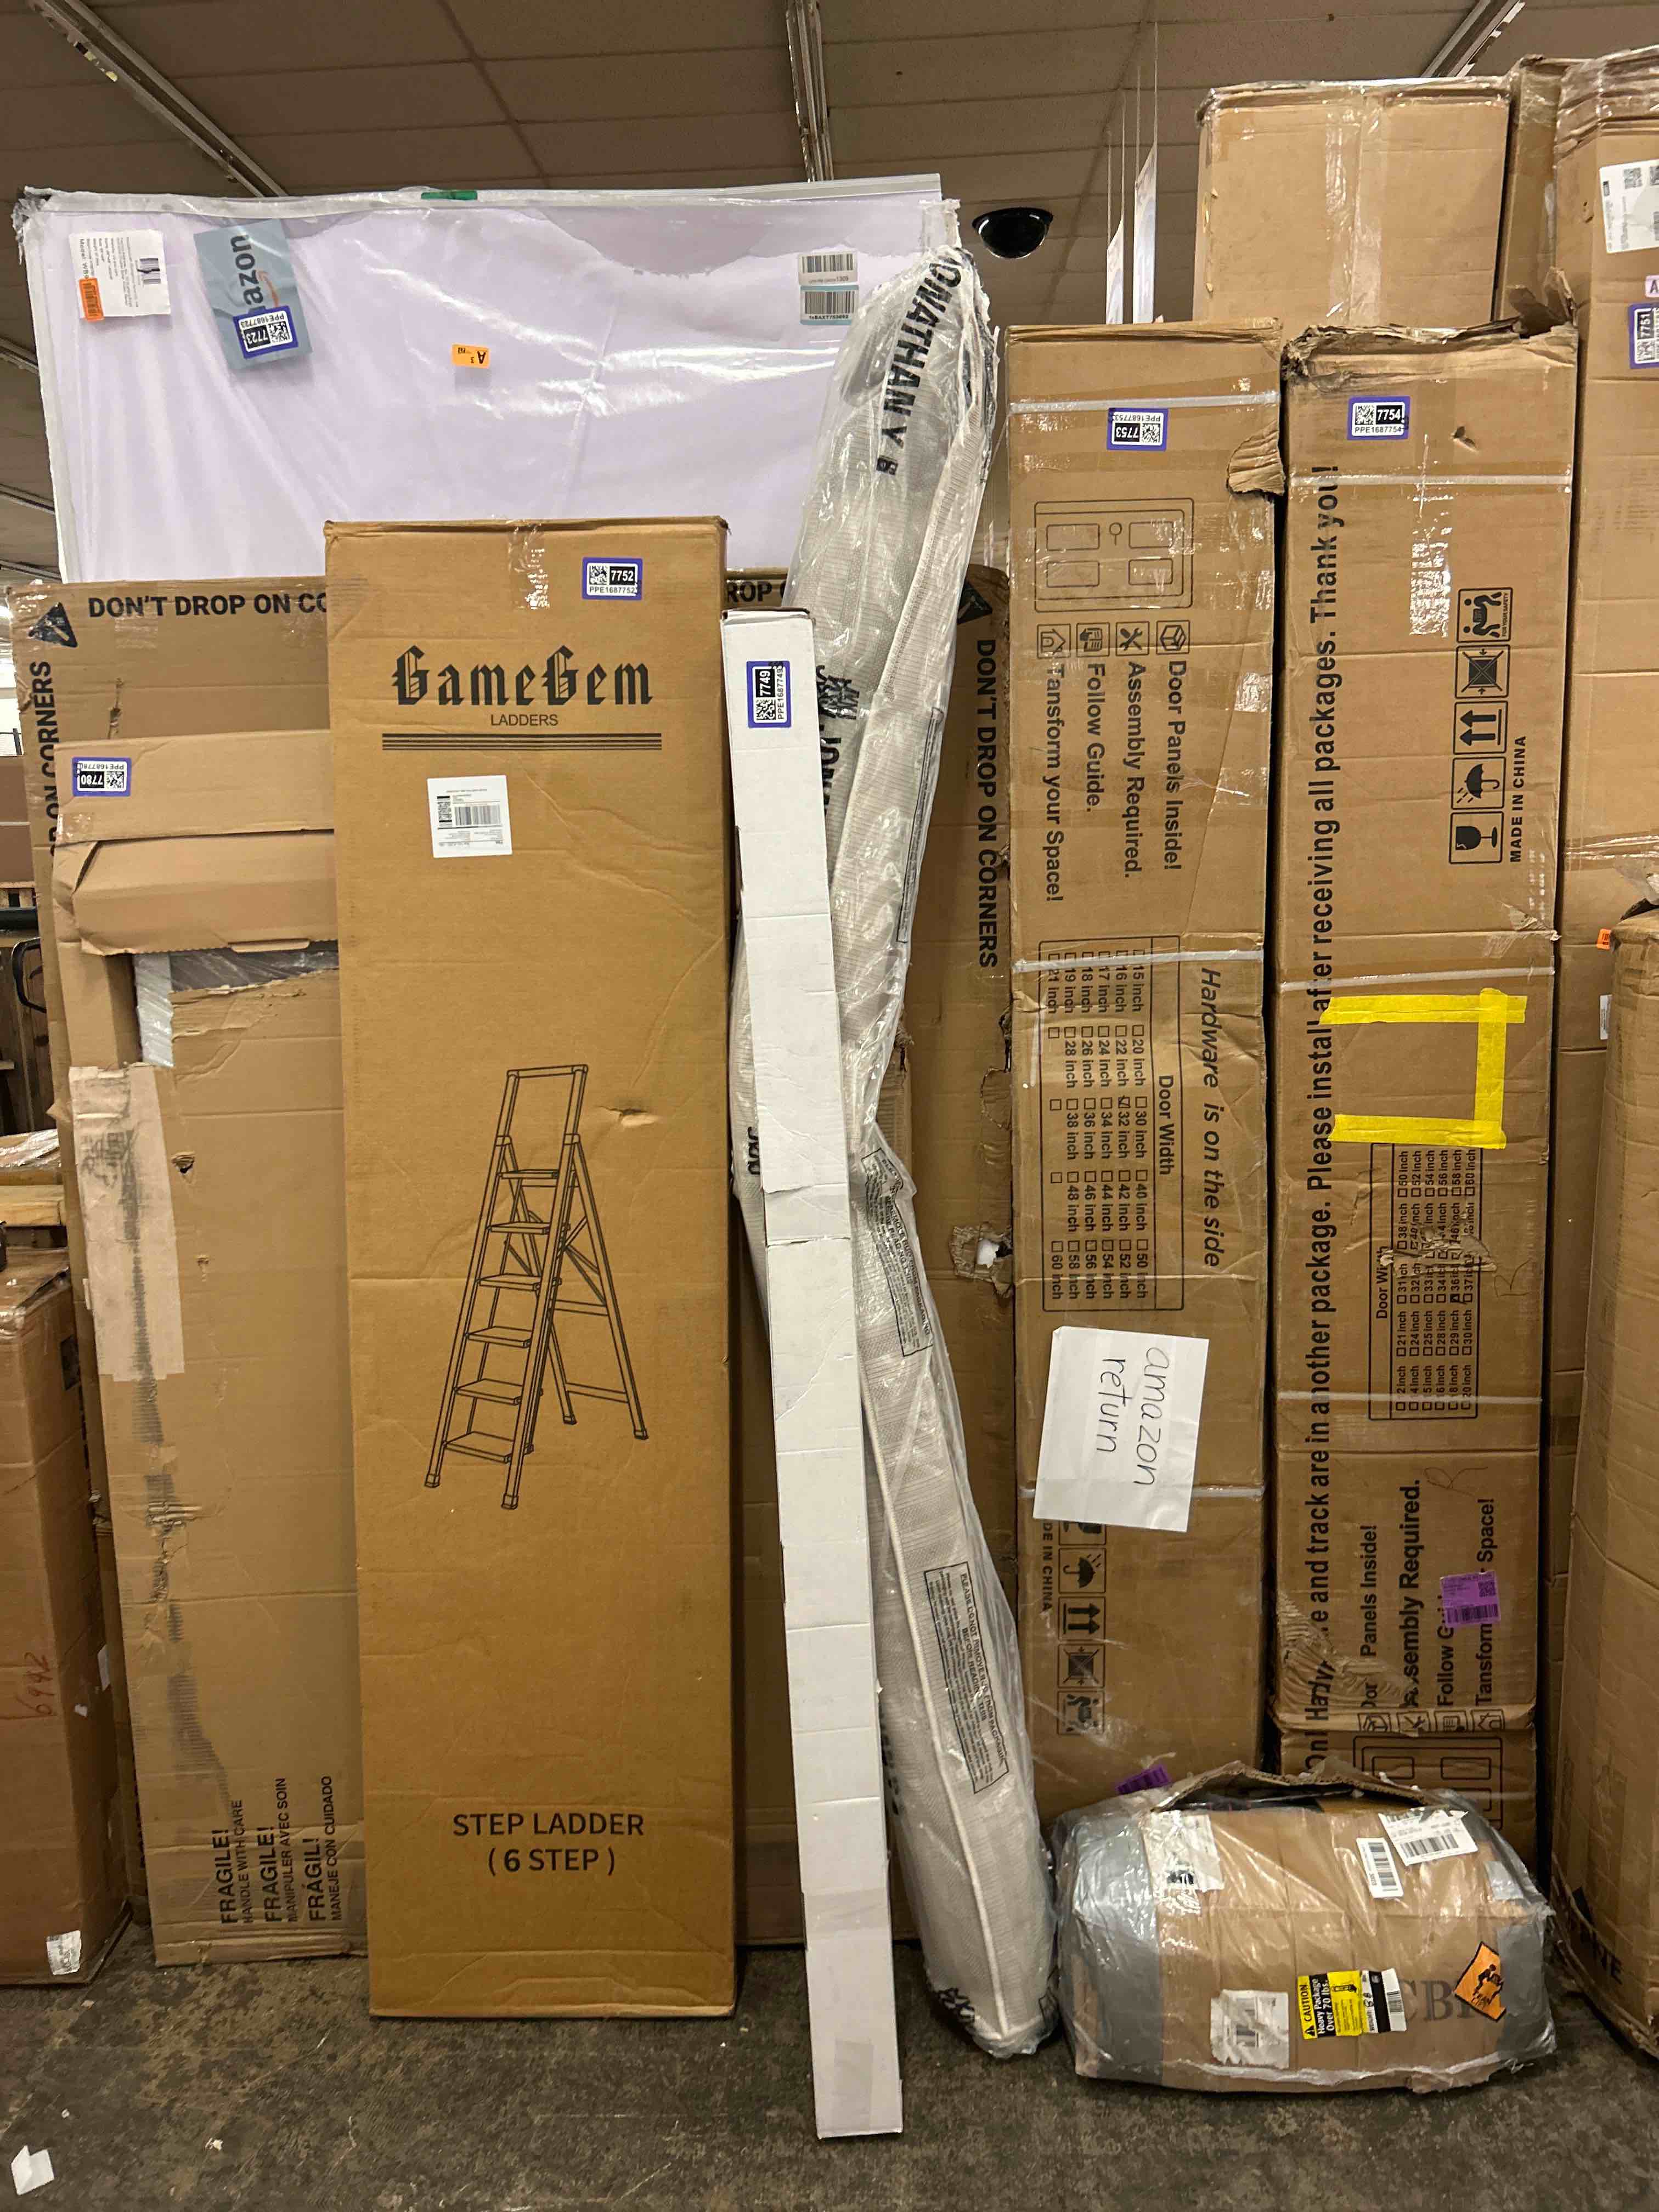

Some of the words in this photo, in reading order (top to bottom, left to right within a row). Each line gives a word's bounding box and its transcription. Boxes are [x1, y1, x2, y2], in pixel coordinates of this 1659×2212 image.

[230, 235, 266, 314] azon
[246, 330, 268, 345] 7723
[1377, 409, 1401, 421] 7754
[882, 426, 907, 449] Y
[1115, 426, 1139, 438] 7753
[611, 570, 634, 582] 7752
[1311, 535, 1336, 624] Thank
[88, 595, 167, 618] DON'T
[175, 594, 245, 616] DROP
[253, 594, 290, 614] ON
[725, 580, 772, 603] ROP
[391, 645, 653, 706] GameGem
[759, 670, 771, 696] 7749
[977, 639, 996, 720] DON'T
[1167, 660, 1186, 714] Door
[776, 668, 785, 720] PPE1687749
[1087, 663, 1105, 736] Follow
[1310, 631, 1342, 772] packages.
[30, 661, 60, 778] CORNERS
[490, 714, 558, 727] LADDERS
[1122, 661, 1146, 770] Assembly
[977, 727, 996, 799] DROP
[1166, 720, 1186, 794] Panels
[1513, 736, 1526, 788] CHINA
[81, 774, 104, 785] 7780
[1086, 742, 1105, 812] Guide.
[1042, 775, 1060, 825] your
[1308, 782, 1334, 812] all
[1511, 794, 1523, 811] IN
[977, 804, 997, 842] ON
[1122, 776, 1145, 878] Required.
[1164, 800, 1183, 870] Inside!
[1510, 815, 1523, 863] MADE
[1042, 830, 1064, 902] Space!
[1307, 821, 1340, 944] receiving
[978, 849, 997, 968] CORNERS
[1115, 965, 1127, 980] 16
[1133, 965, 1144, 979] 15
[1115, 984, 1127, 1013] inch
[1132, 984, 1144, 1012] inch
[1201, 968, 1221, 1088] Hardware
[1065, 1041, 1076, 1056] 28
[1081, 1040, 1093, 1056] 26
[1098, 1040, 1110, 1056] 24
[1115, 1040, 1127, 1055] 22
[1132, 1039, 1144, 1054] 20
[1065, 1060, 1078, 1088] inch
[1082, 1060, 1095, 1088] inch
[1099, 1059, 1112, 1087] inch
[1116, 1059, 1129, 1087] inch
[1133, 1058, 1146, 1086] inch
[1158, 1074, 1175, 1120] Door
[1067, 1113, 1079, 1128] 38
[1084, 1113, 1096, 1128] 36
[1101, 1112, 1113, 1127] 34
[1118, 1111, 1130, 1126] 32
[1135, 1111, 1147, 1126] 30
[1203, 1102, 1220, 1122] is
[1067, 1132, 1079, 1160] inch
[1084, 1132, 1096, 1159] inch
[1101, 1132, 1113, 1159] inch
[1118, 1131, 1130, 1159] inch
[1135, 1131, 1147, 1159] inch
[1159, 1123, 1175, 1175] Width
[1204, 1130, 1220, 1161] on
[1307, 1107, 1333, 1190] Please
[1398, 1150, 1408, 1172] inch
[1412, 1150, 1421, 1172] inch
[1425, 1149, 1435, 1172] inch
[1135, 1184, 1147, 1199] 40
[1204, 1167, 1224, 1209] the
[1398, 1174, 1408, 1186] 50
[1412, 1173, 1421, 1186] 52
[1425, 1173, 1435, 1186] 54
[1136, 1203, 1148, 1231] inch
[1204, 1217, 1224, 1267] side
[1306, 1200, 1338, 1313] package.
[1052, 1255, 1063, 1270] 60
[1376, 1287, 1387, 1319] Door
[1397, 1311, 1407, 1332] inch
[1463, 1310, 1472, 1330] inch
[1398, 1334, 1406, 1346] 21
[1463, 1333, 1472, 1345] 30
[1096, 1358, 1133, 1453] return
[1132, 1346, 1170, 1486] amazon
[1305, 1422, 1329, 1443] in
[1311, 1450, 1329, 1487] are
[1043, 1521, 1053, 1541] DE
[1305, 1493, 1329, 1554] track
[1399, 1479, 1425, 1588] Required.
[1476, 1498, 1497, 1563] Space!
[1043, 1545, 1053, 1561] IN
[1360, 1525, 1377, 1587] Inside!
[1042, 1566, 1053, 1612] CHINA
[1305, 1561, 1329, 1603] and
[1360, 1593, 1377, 1657] Panels
[1437, 1645, 1454, 1706] Follow
[275, 1777, 288, 1809] SOIN
[321, 1775, 336, 1835] CUIDADO
[231, 1799, 246, 1837] CARE
[277, 1812, 292, 1847] AVEC
[453, 1812, 524, 1836] STEP
[533, 1812, 644, 1836] LADDER
[235, 1839, 249, 1871] WITH
[324, 1839, 338, 1867] CON
[211, 1829, 238, 1924] FRAGILE!
[257, 1826, 283, 1922] FRAGILE!
[279, 1849, 299, 1923] MANIPULER
[302, 1838, 326, 1921] FRAGIL!
[238, 1874, 254, 1923] HANDLE
[326, 1869, 343, 1921] MANEJE
[1299, 1984, 1313, 2022] CAUTION
[1312, 1978, 1323, 2010] Package
[1322, 1997, 1331, 2010] 70
[1317, 2010, 1326, 2035] Heavy
[1326, 2011, 1335, 2032] Over
